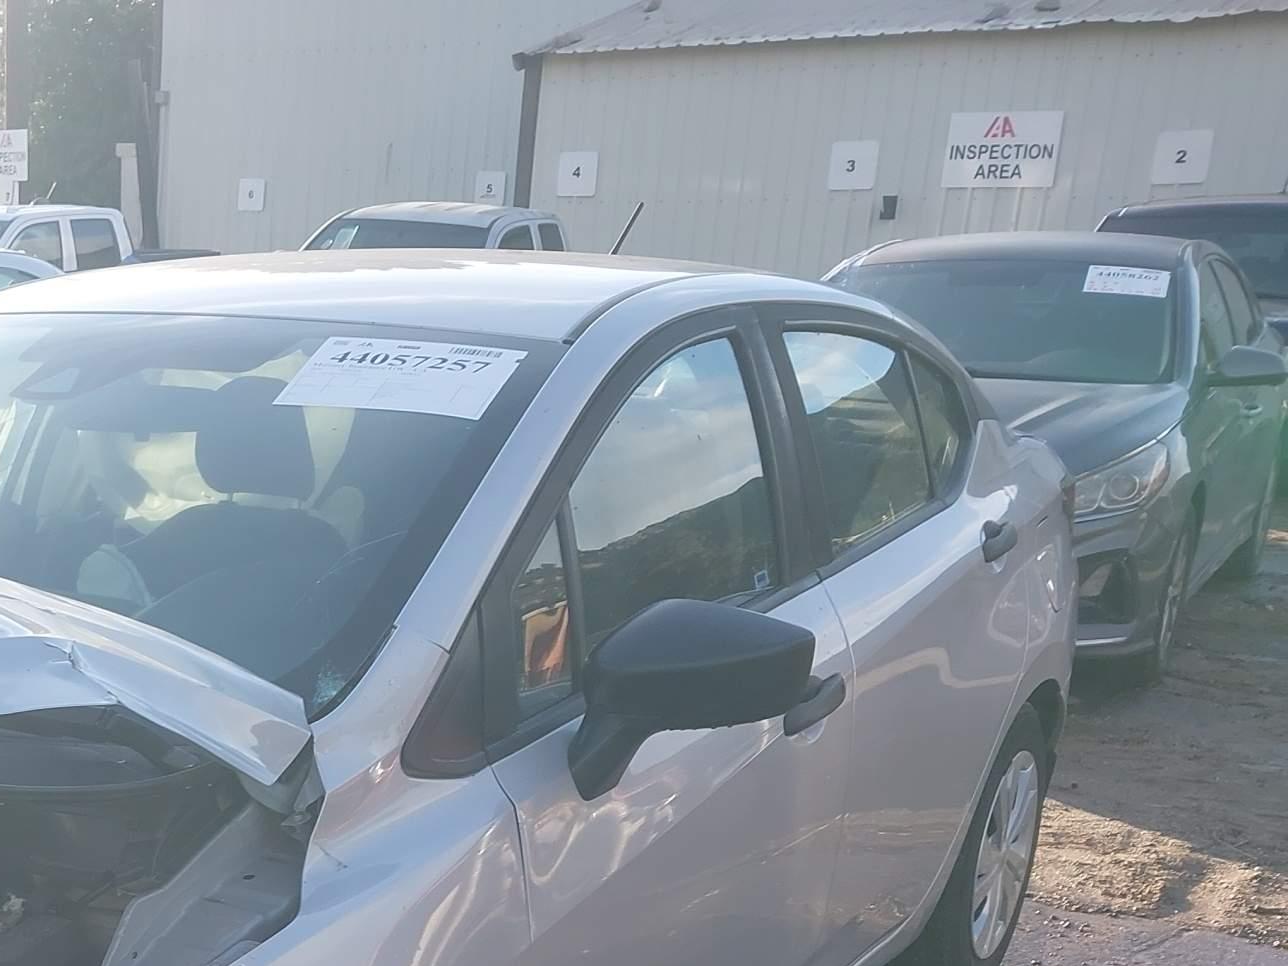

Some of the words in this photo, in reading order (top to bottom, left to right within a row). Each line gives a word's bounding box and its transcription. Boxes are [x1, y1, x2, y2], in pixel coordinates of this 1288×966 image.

[949, 143, 1054, 160] INSPECTION
[1175, 150, 1188, 164] 2
[572, 166, 581, 178] 4
[845, 159, 856, 172] 3
[974, 163, 1022, 179] AREA
[486, 183, 493, 193] 5
[330, 350, 492, 374] 44057257
